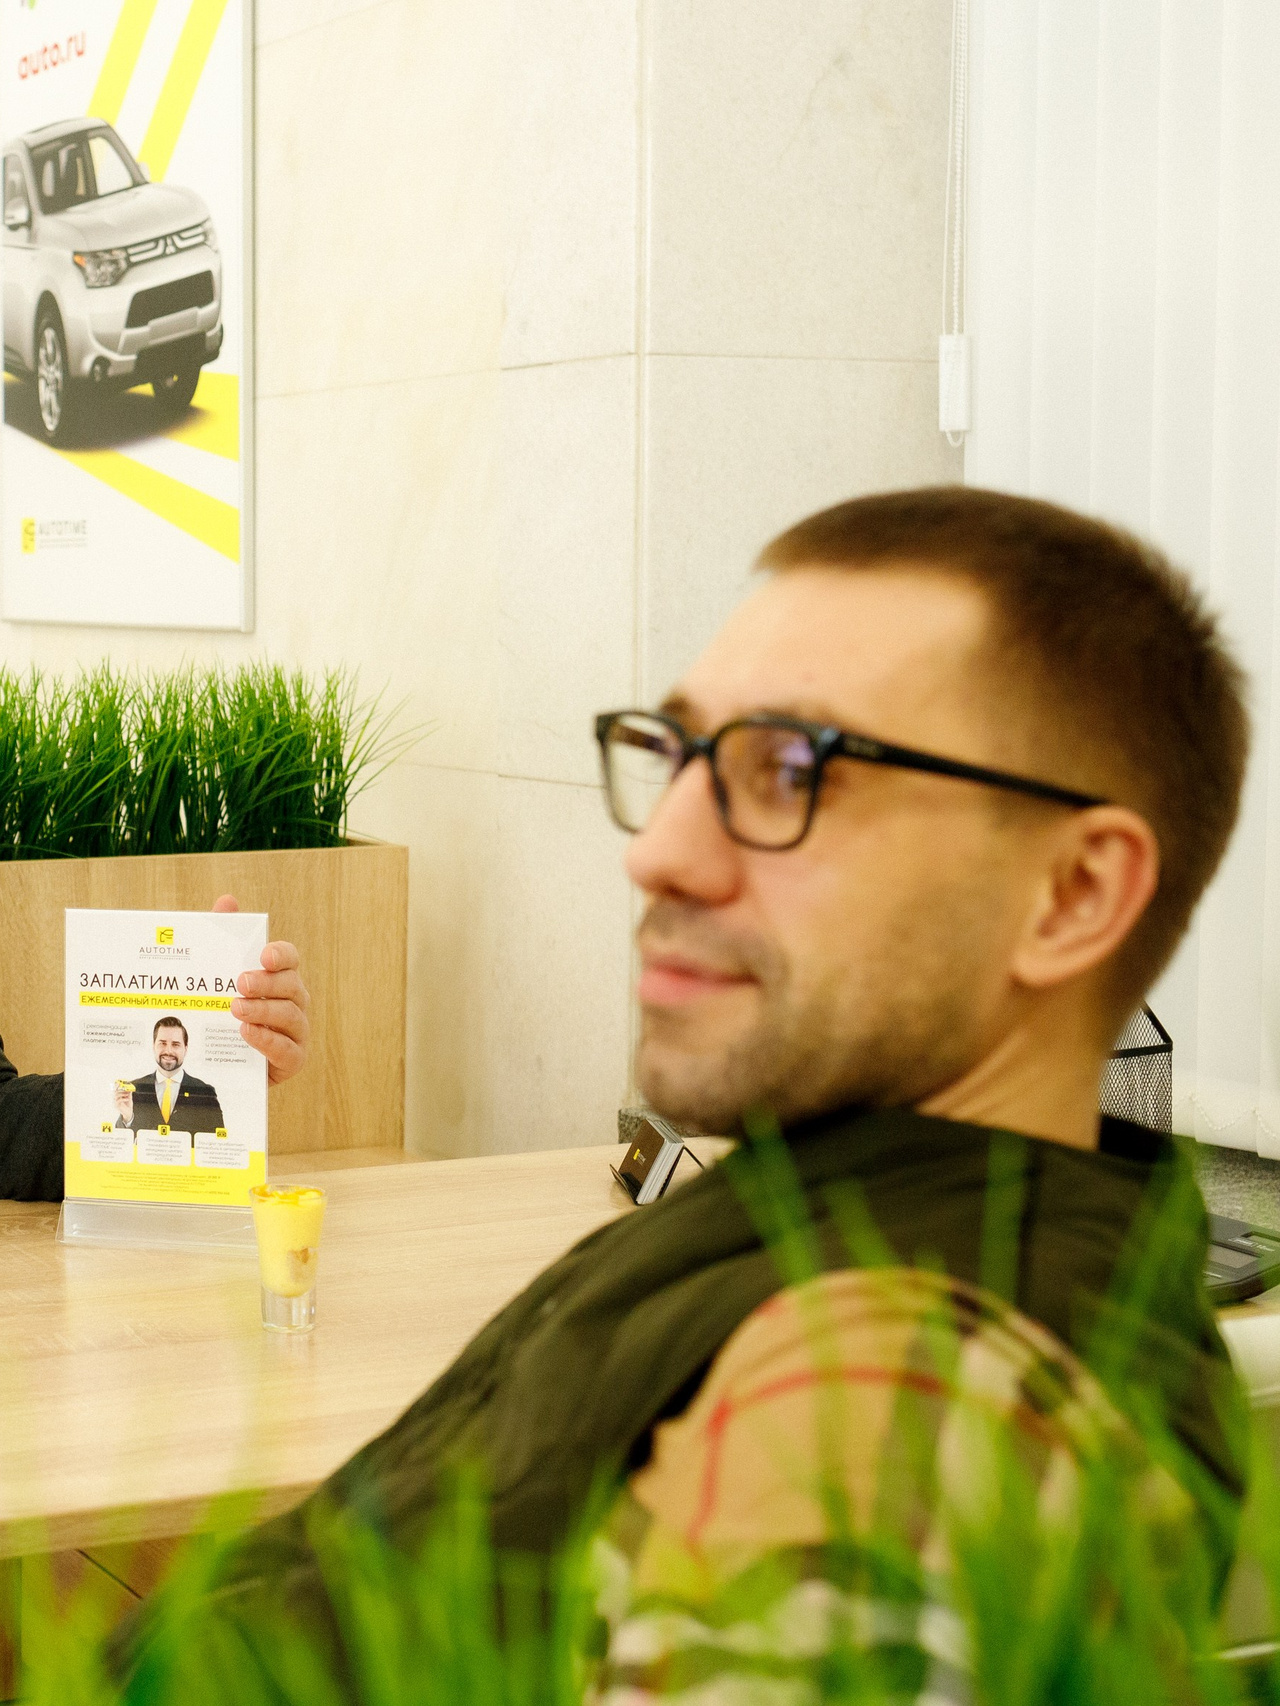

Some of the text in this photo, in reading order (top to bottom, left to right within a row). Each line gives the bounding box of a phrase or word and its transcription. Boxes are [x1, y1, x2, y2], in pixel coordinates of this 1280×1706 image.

[18, 31, 86, 80] auto.ru
[139, 946, 190, 955] AUTOTIME
[79, 973, 237, 993] ЗАПЛАТИМ ЗА ВА
[81, 995, 149, 1006] ЕЖЕМЕСЯЧНЫЙ
[152, 997, 188, 1007] ПЛАТЕЖ
[190, 999, 203, 1008] ПО
